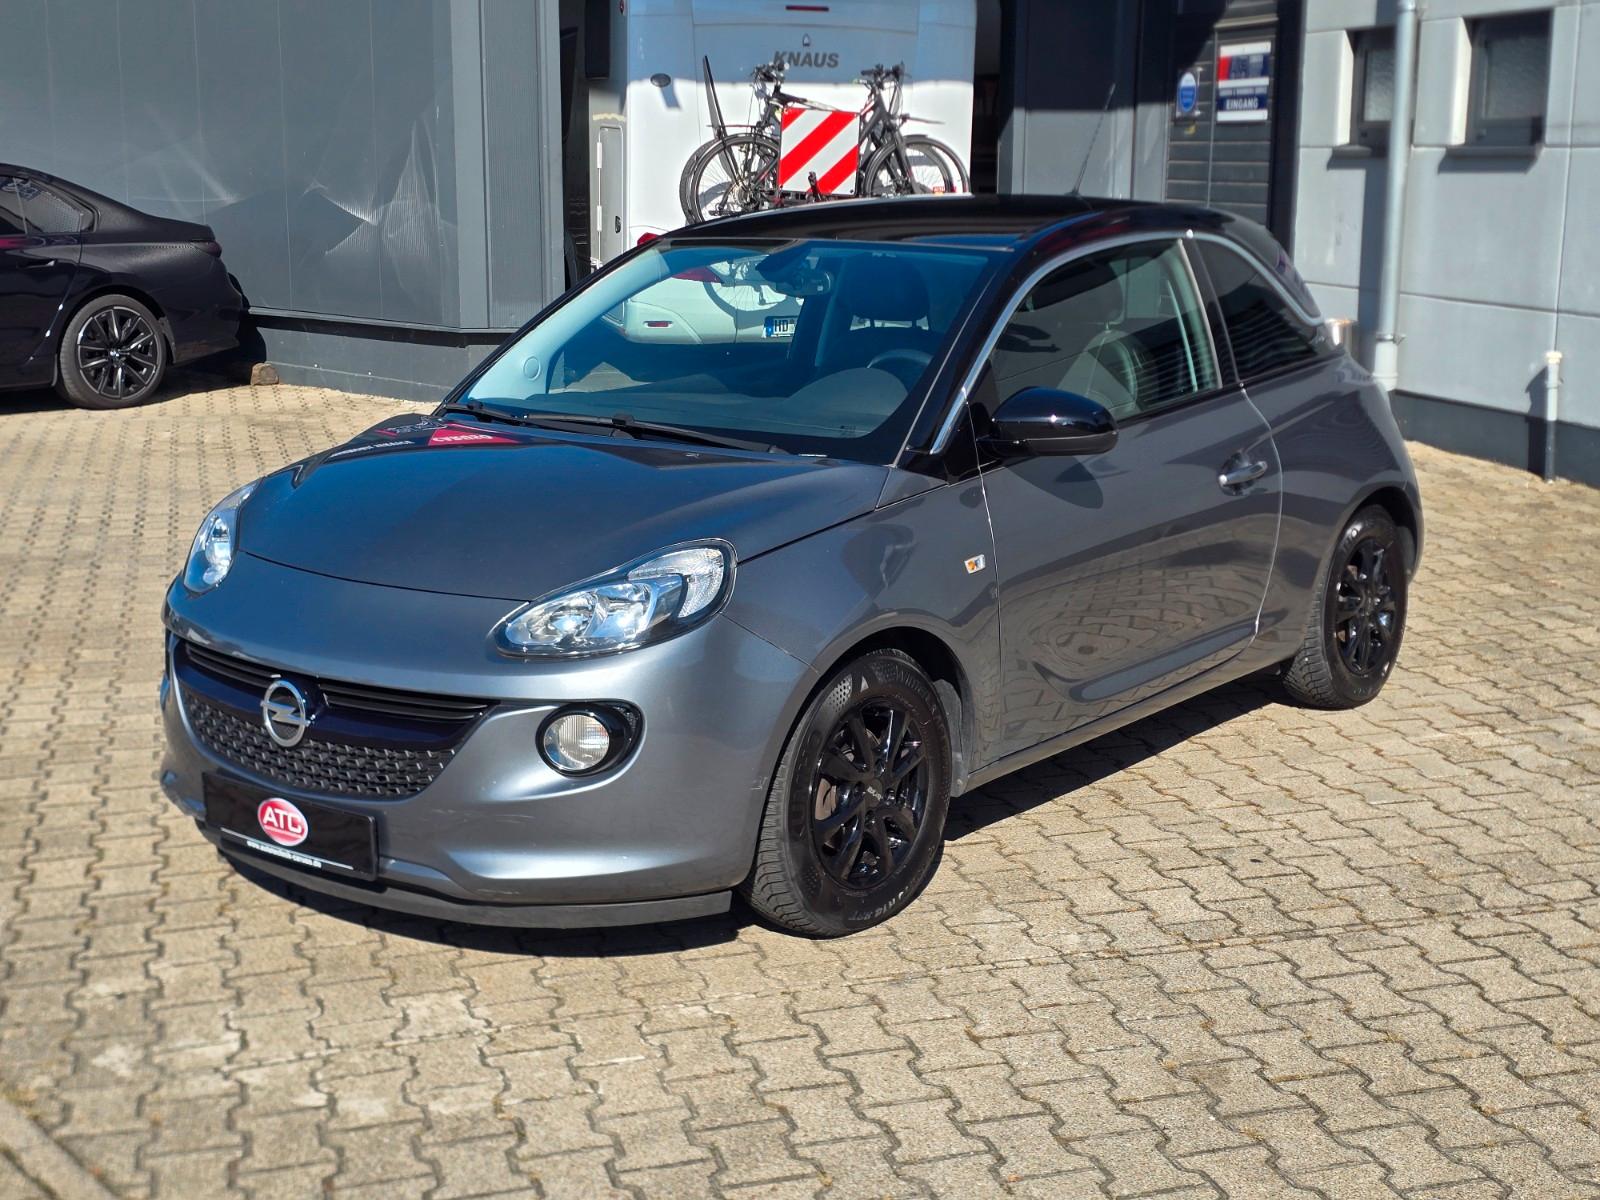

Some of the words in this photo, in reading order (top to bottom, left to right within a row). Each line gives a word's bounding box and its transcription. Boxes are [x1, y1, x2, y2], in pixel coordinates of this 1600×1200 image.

[773, 51, 840, 68] KNAUS
[1226, 97, 1259, 110] EINGANG
[262, 806, 303, 834] ATC
